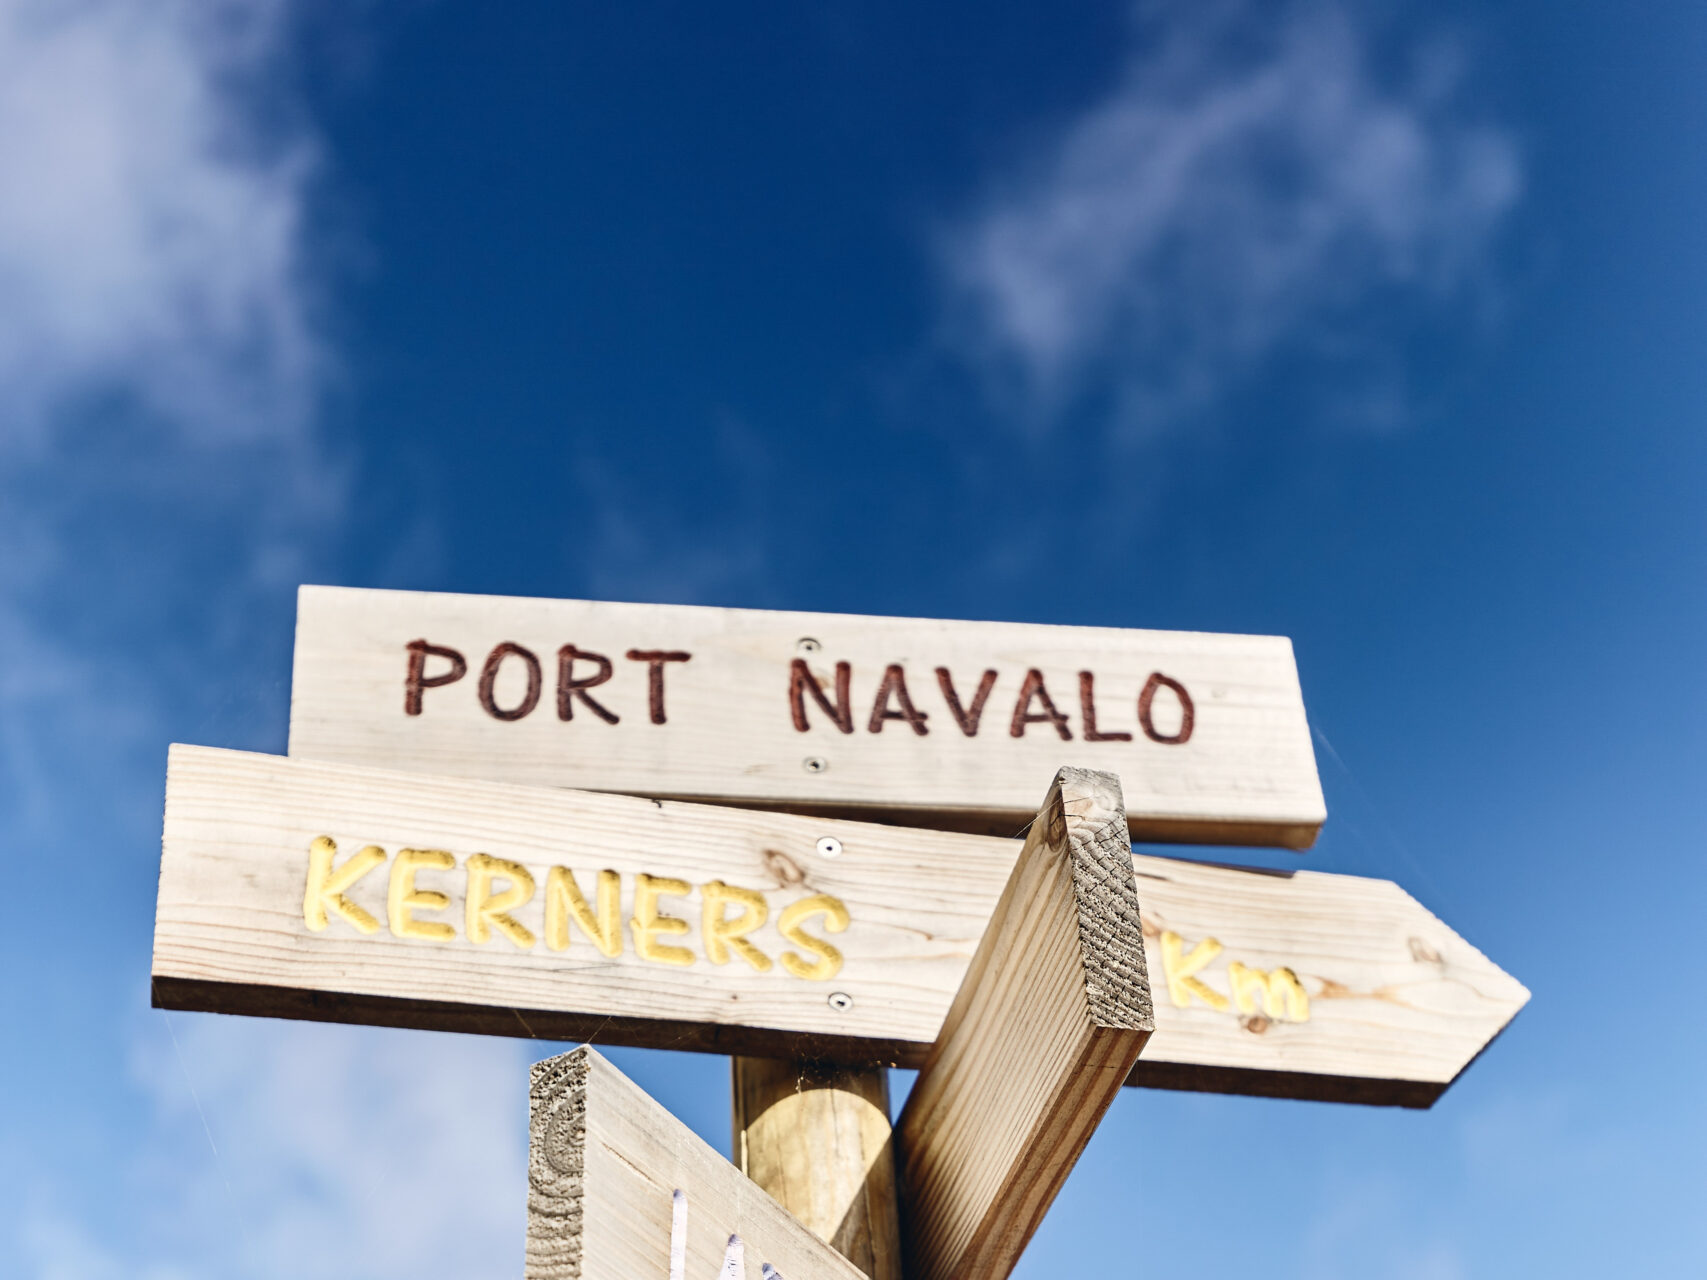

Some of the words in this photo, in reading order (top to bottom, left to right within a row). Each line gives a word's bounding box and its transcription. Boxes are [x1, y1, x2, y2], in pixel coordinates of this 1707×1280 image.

[404, 638, 692, 725] PORT
[788, 656, 1196, 746] NAVALO
[302, 834, 852, 981] KERNERS
[1160, 930, 1311, 1023] Km
